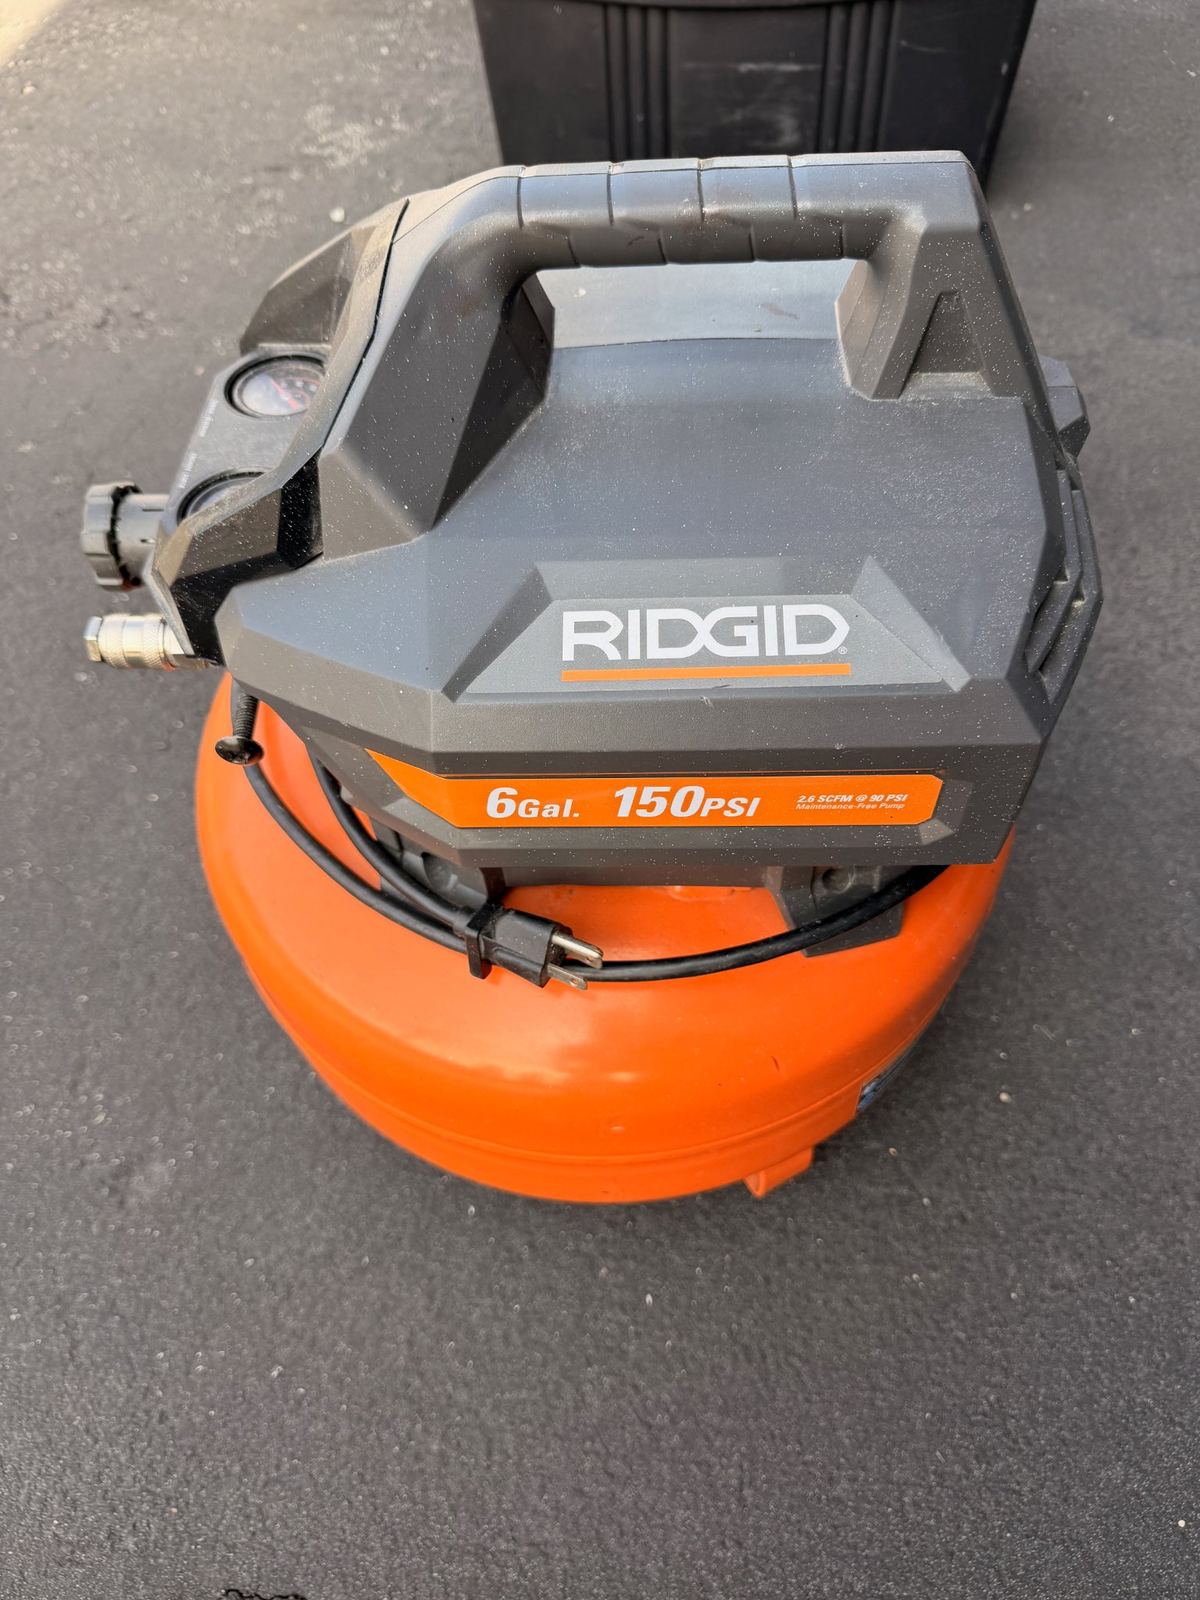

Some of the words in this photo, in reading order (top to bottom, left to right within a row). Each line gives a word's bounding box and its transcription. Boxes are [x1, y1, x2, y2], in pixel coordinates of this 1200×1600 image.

[486, 787, 580, 818] 6Gal.
[614, 786, 761, 818] 150PSI
[797, 795, 815, 803] 2.6
[817, 794, 853, 803] SCFM
[855, 794, 868, 803] @
[869, 794, 884, 802] 90
[886, 793, 908, 802] PSI
[796, 802, 877, 810] Maintenance-Free
[879, 802, 905, 810] Pump
